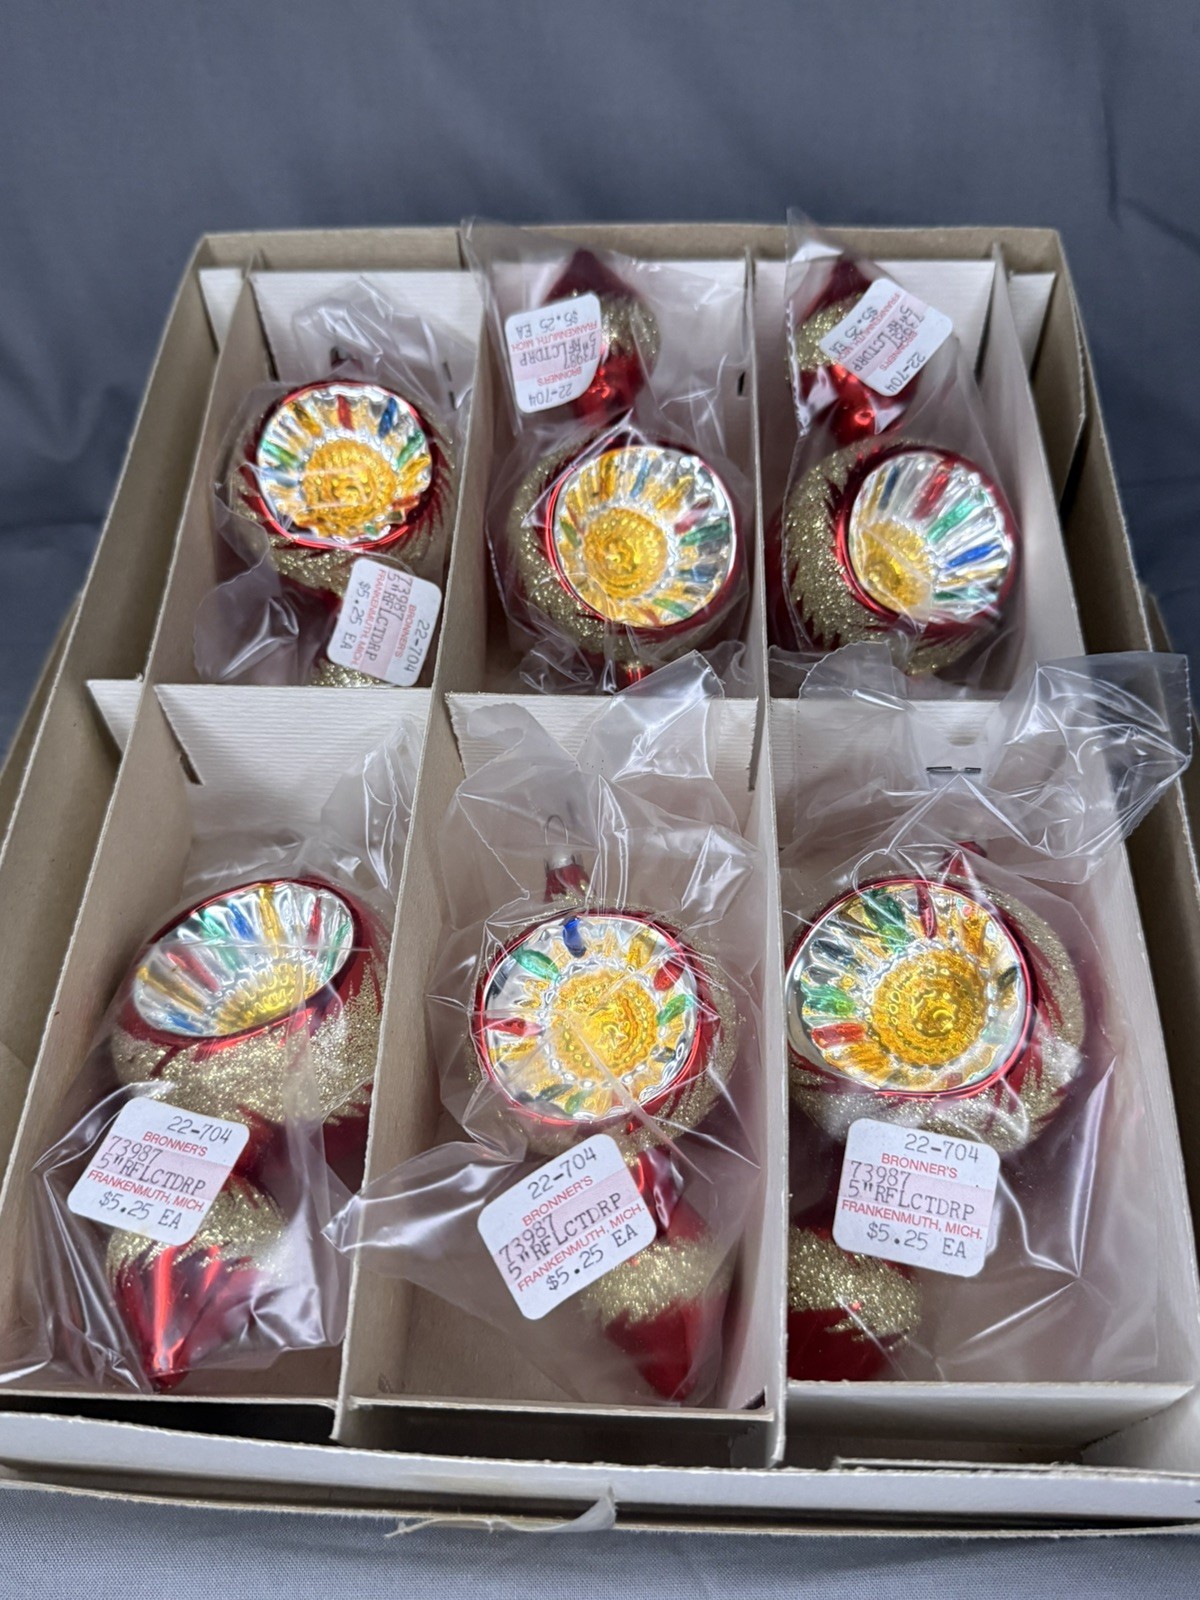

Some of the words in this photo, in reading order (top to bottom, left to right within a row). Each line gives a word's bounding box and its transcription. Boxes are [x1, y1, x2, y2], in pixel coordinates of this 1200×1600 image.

[516, 323, 532, 339] EA
[540, 310, 578, 333] $5.25
[845, 306, 878, 340] $5.25
[564, 346, 598, 369] 73987
[829, 341, 848, 355] EA
[885, 352, 926, 393] 22-704
[528, 383, 572, 407] 22-704
[350, 581, 371, 625] $5.25
[366, 571, 400, 661] 5"RFLCTDRP
[393, 574, 413, 622] 73987
[340, 632, 357, 649] EA
[404, 619, 431, 673] 22-704
[108, 1135, 163, 1164] 73987
[143, 1131, 208, 1157] BRONNER'S
[167, 1115, 233, 1144] 22-704
[904, 1133, 979, 1164] 22-704
[96, 1152, 206, 1195] 5"RFLCTDRP
[527, 1146, 597, 1200] 22-704
[850, 1160, 911, 1190] 73987
[881, 1152, 958, 1179] BRONNER'S
[87, 1169, 171, 1203] FRANKENMUTH,
[173, 1195, 205, 1213] MICH.
[99, 1190, 153, 1221] $5.25
[157, 1208, 183, 1230] EA
[522, 1175, 594, 1227] BRONNER'S
[848, 1179, 975, 1222] 5"RFLCTDRP
[499, 1213, 556, 1263] 73987
[507, 1192, 622, 1281] 5"RFLCTDRP
[841, 1199, 942, 1233] FRANKENMUTH,
[945, 1221, 983, 1240] MICH.
[517, 1225, 610, 1292] FRANKENMUTH,
[610, 1203, 645, 1229] MICH.
[546, 1243, 604, 1291] $5.25
[611, 1223, 639, 1248] EA
[866, 1221, 929, 1251] $5.25
[942, 1237, 967, 1259] EA
